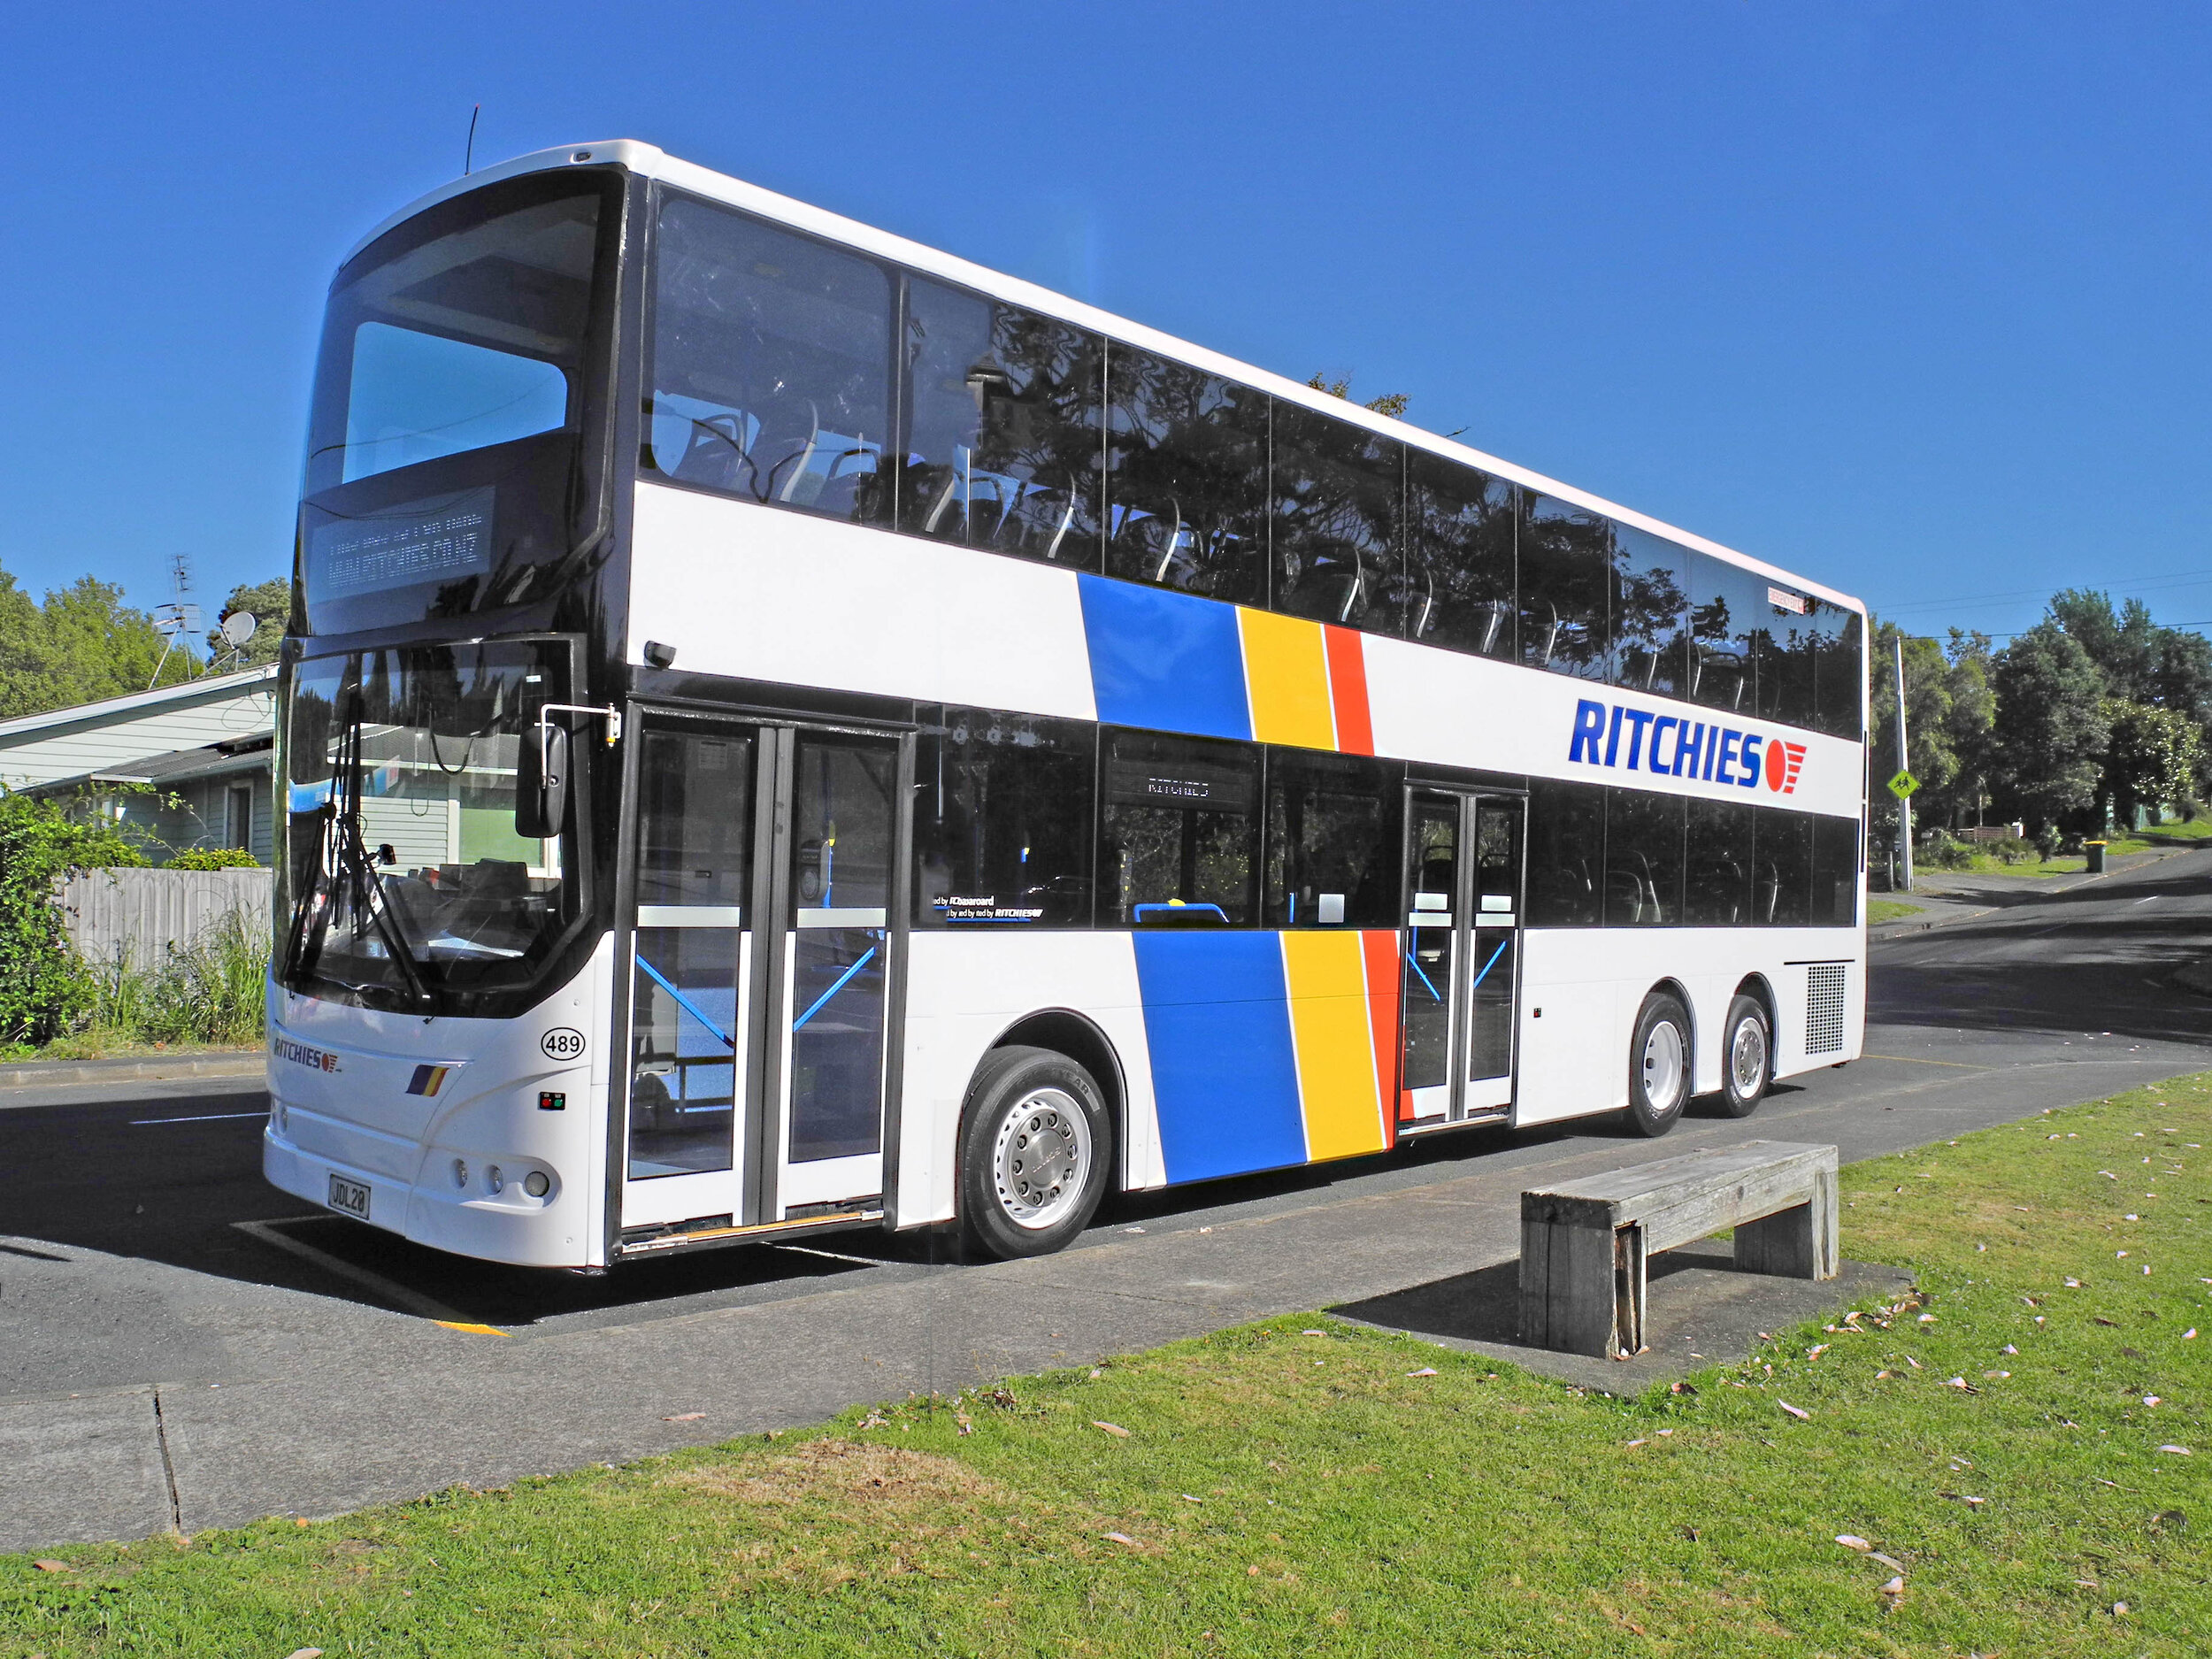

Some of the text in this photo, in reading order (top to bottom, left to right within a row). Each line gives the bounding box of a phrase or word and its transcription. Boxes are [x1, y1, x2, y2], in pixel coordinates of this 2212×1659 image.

[1568, 698, 1763, 788] RITCHIES
[274, 1037, 322, 1069] RITCHIES
[545, 1035, 580, 1053] 489
